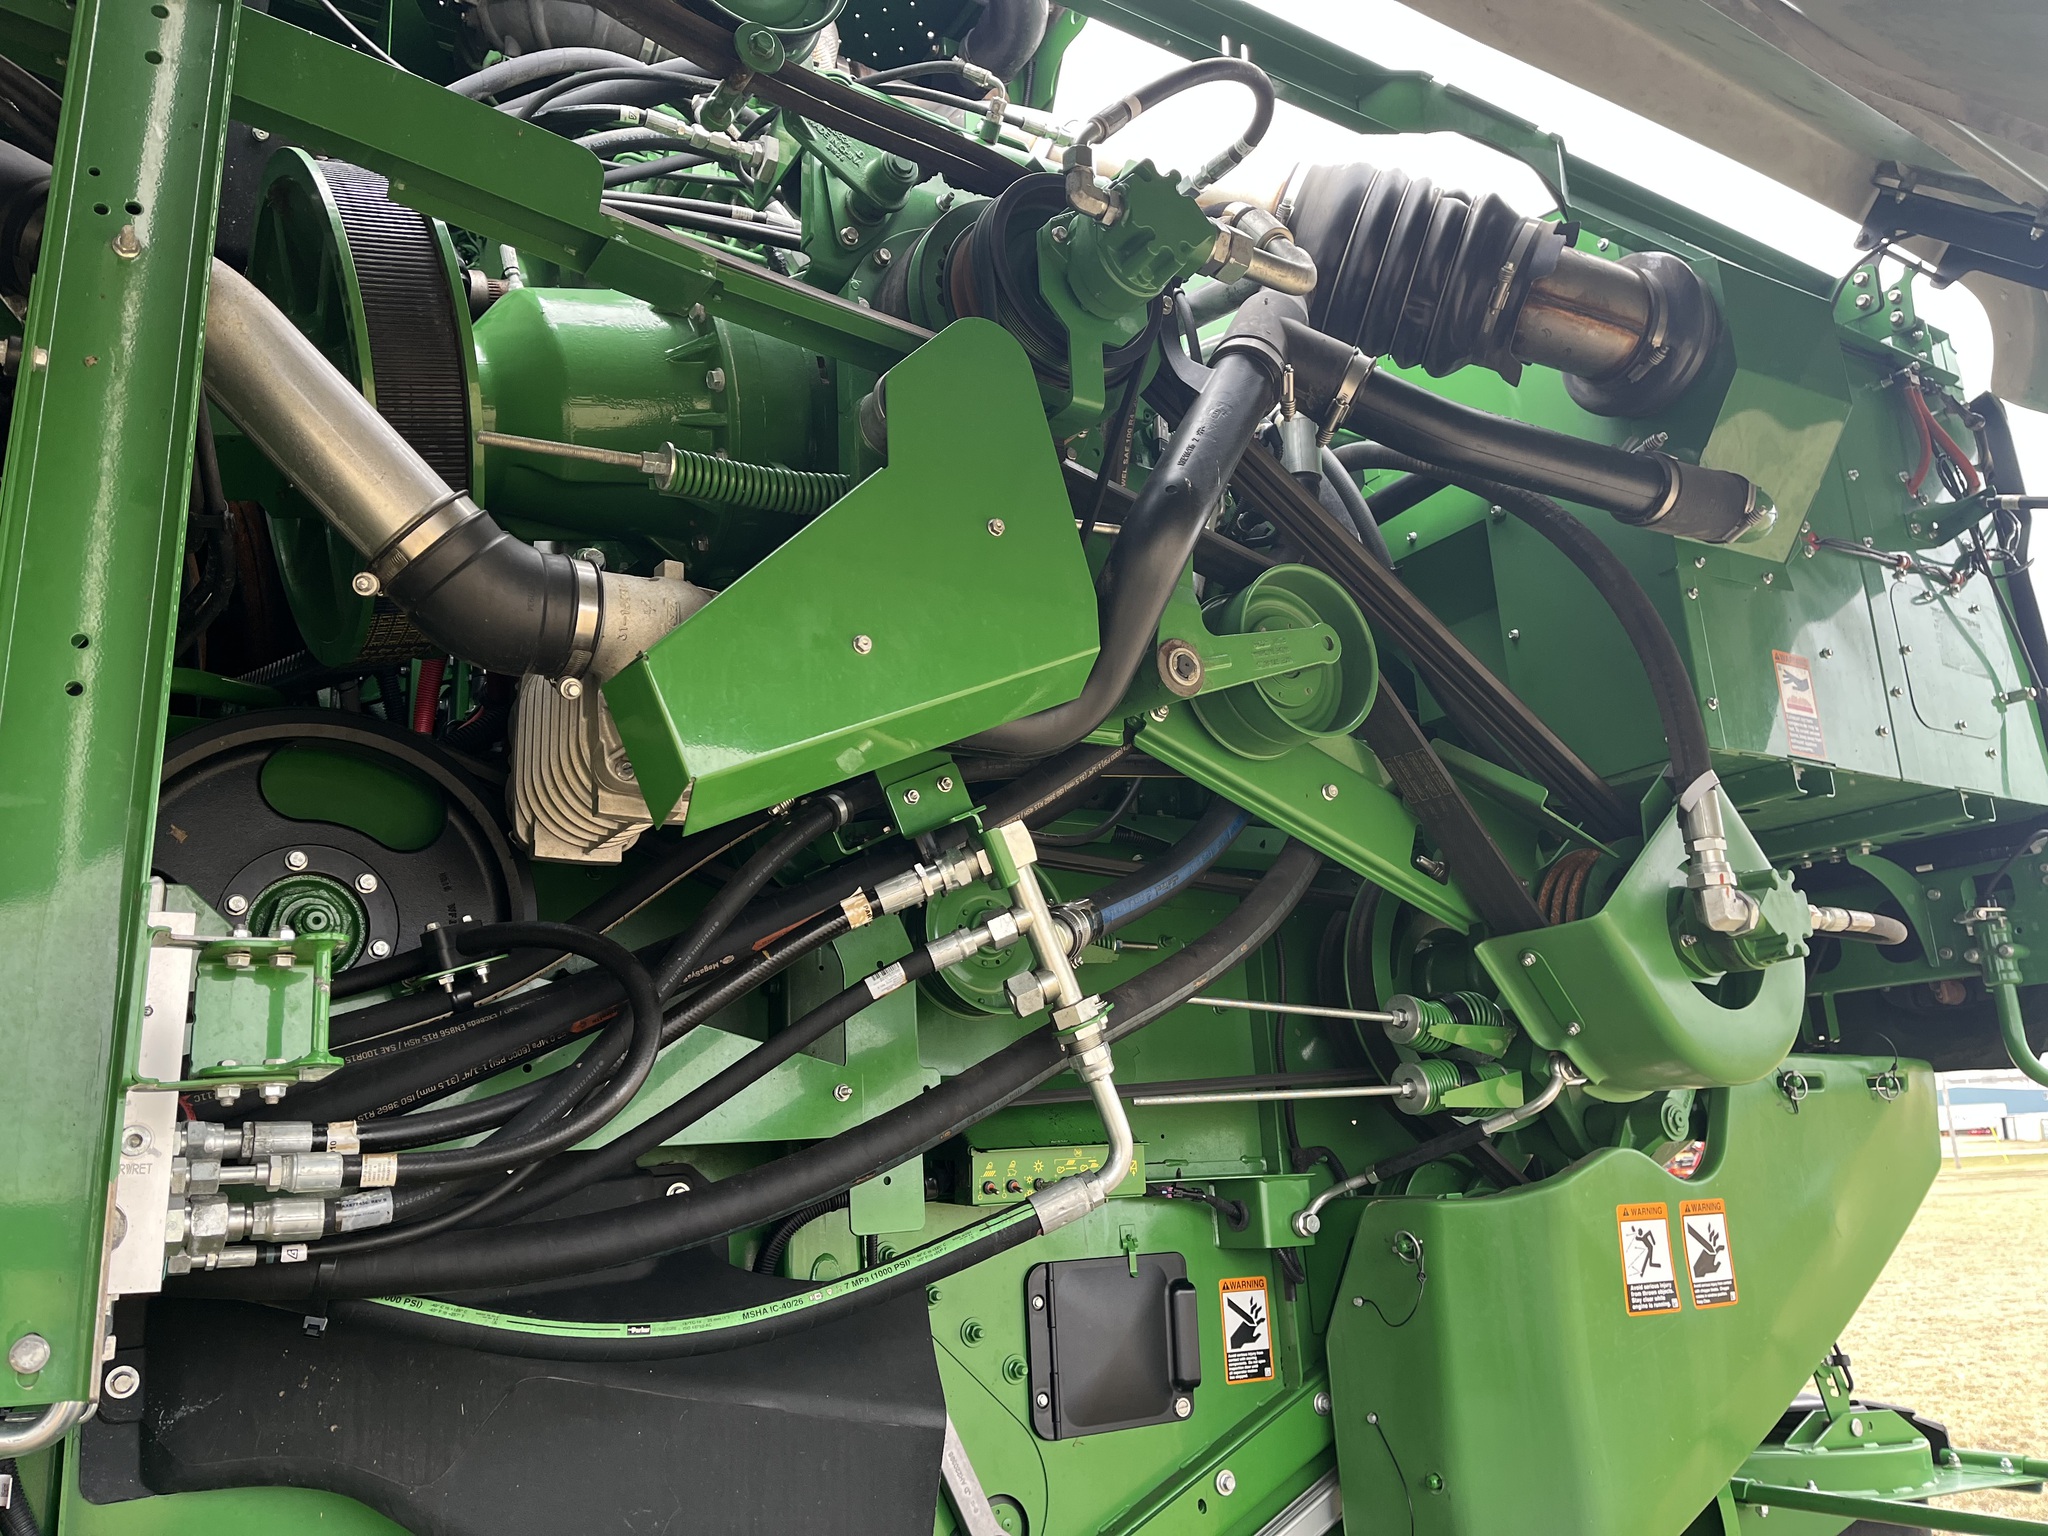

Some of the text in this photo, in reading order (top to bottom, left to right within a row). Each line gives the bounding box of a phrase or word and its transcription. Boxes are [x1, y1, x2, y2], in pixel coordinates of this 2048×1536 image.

[440, 1022, 466, 1039] EN856
[404, 1035, 421, 1047] 4SH
[422, 1031, 439, 1043] R15
[381, 1042, 397, 1053] SAE
[345, 1047, 379, 1063] 100R15
[400, 1093, 416, 1107] ISO
[376, 1098, 399, 1116] 3862
[1630, 1206, 1663, 1217] WARNING
[1691, 1201, 1722, 1213] WARNING
[742, 1307, 769, 1321] MSHA
[770, 1298, 804, 1317] IC-40/26
[851, 1275, 871, 1289] MPa
[871, 1266, 893, 1284] (1000
[893, 1258, 912, 1274] PSI)
[1229, 1278, 1265, 1290] WARNING
[403, 1297, 424, 1309] PSI)
